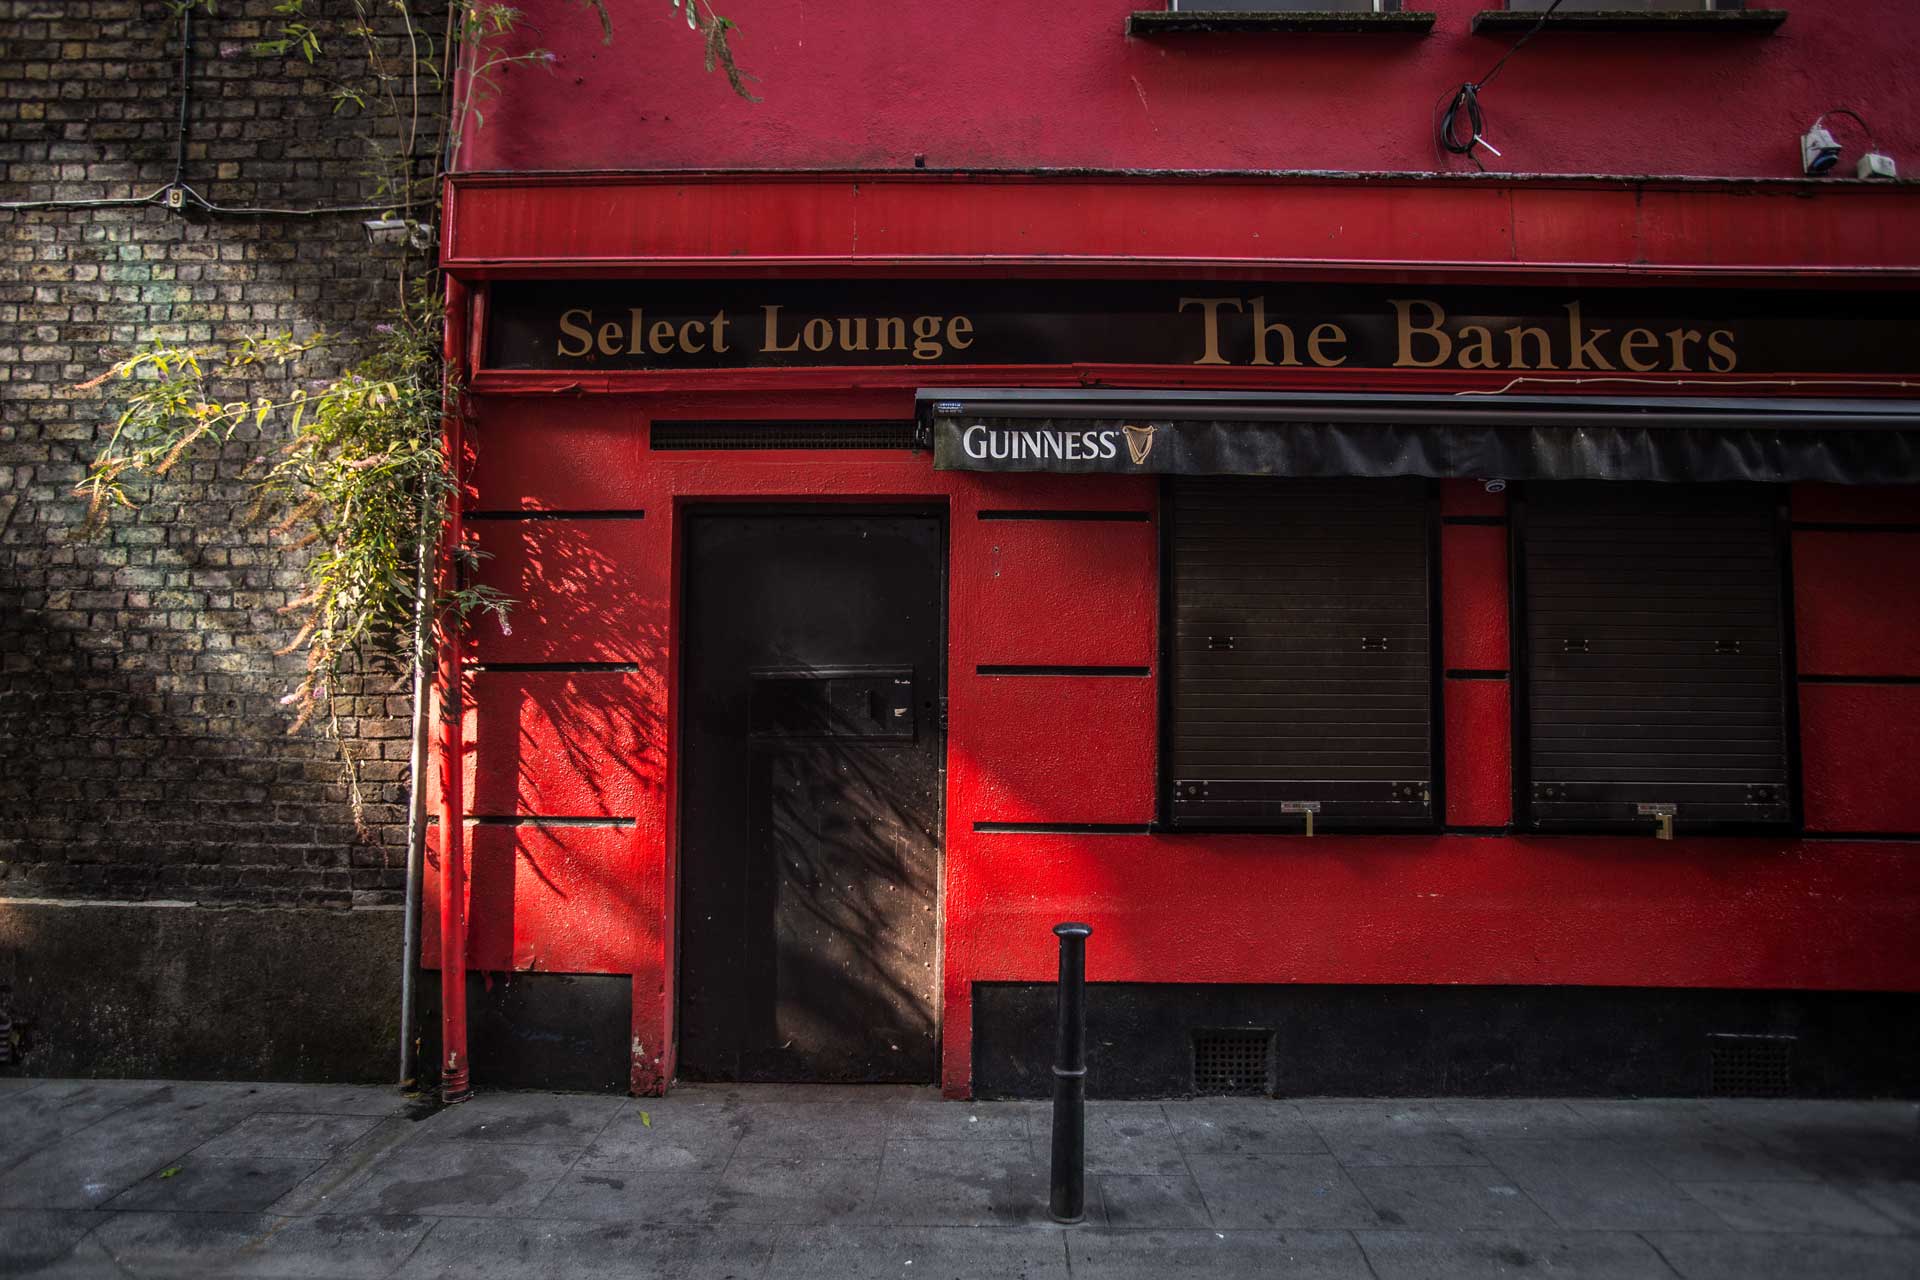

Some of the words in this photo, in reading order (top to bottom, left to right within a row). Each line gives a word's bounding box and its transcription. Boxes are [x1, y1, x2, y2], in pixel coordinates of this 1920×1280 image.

[557, 308, 731, 358] Select
[759, 304, 975, 360] Lounge
[1178, 296, 1348, 368] The
[1390, 298, 1738, 374] Bankers
[962, 424, 1117, 460] GUINNESS
